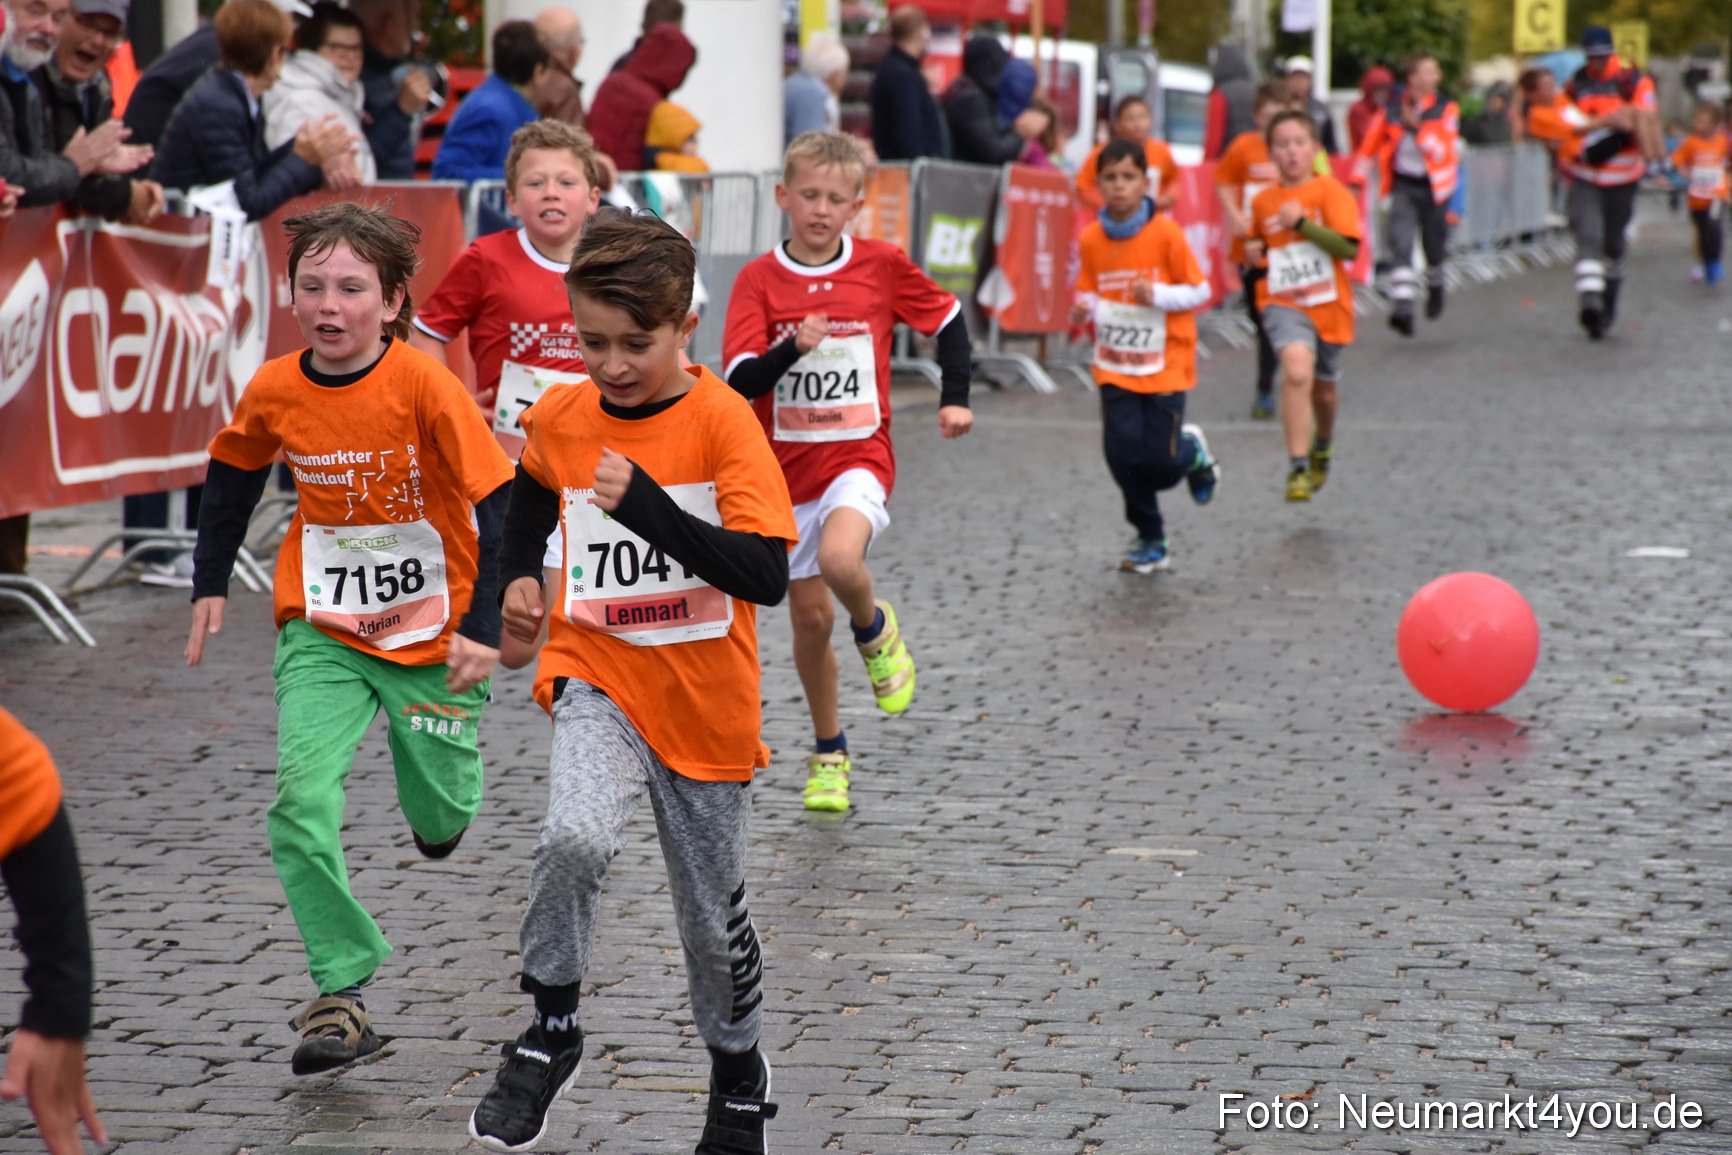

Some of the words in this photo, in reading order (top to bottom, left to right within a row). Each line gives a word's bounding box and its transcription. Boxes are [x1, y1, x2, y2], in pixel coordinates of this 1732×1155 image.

[1527, 3, 1553, 35] C
[1104, 324, 1153, 347] 7227
[788, 368, 860, 401] 7024
[808, 411, 842, 424] Daniel
[286, 449, 373, 467] Neumarkter
[293, 467, 355, 488] Stadtlauf
[406, 444, 425, 518] BAMBINI
[350, 534, 399, 550] BOCK
[324, 557, 425, 606] 7158
[573, 584, 584, 593] B6
[311, 598, 322, 606] B6
[605, 598, 690, 626] Lennart
[357, 613, 401, 635] Adrian
[410, 715, 462, 735] STAR
